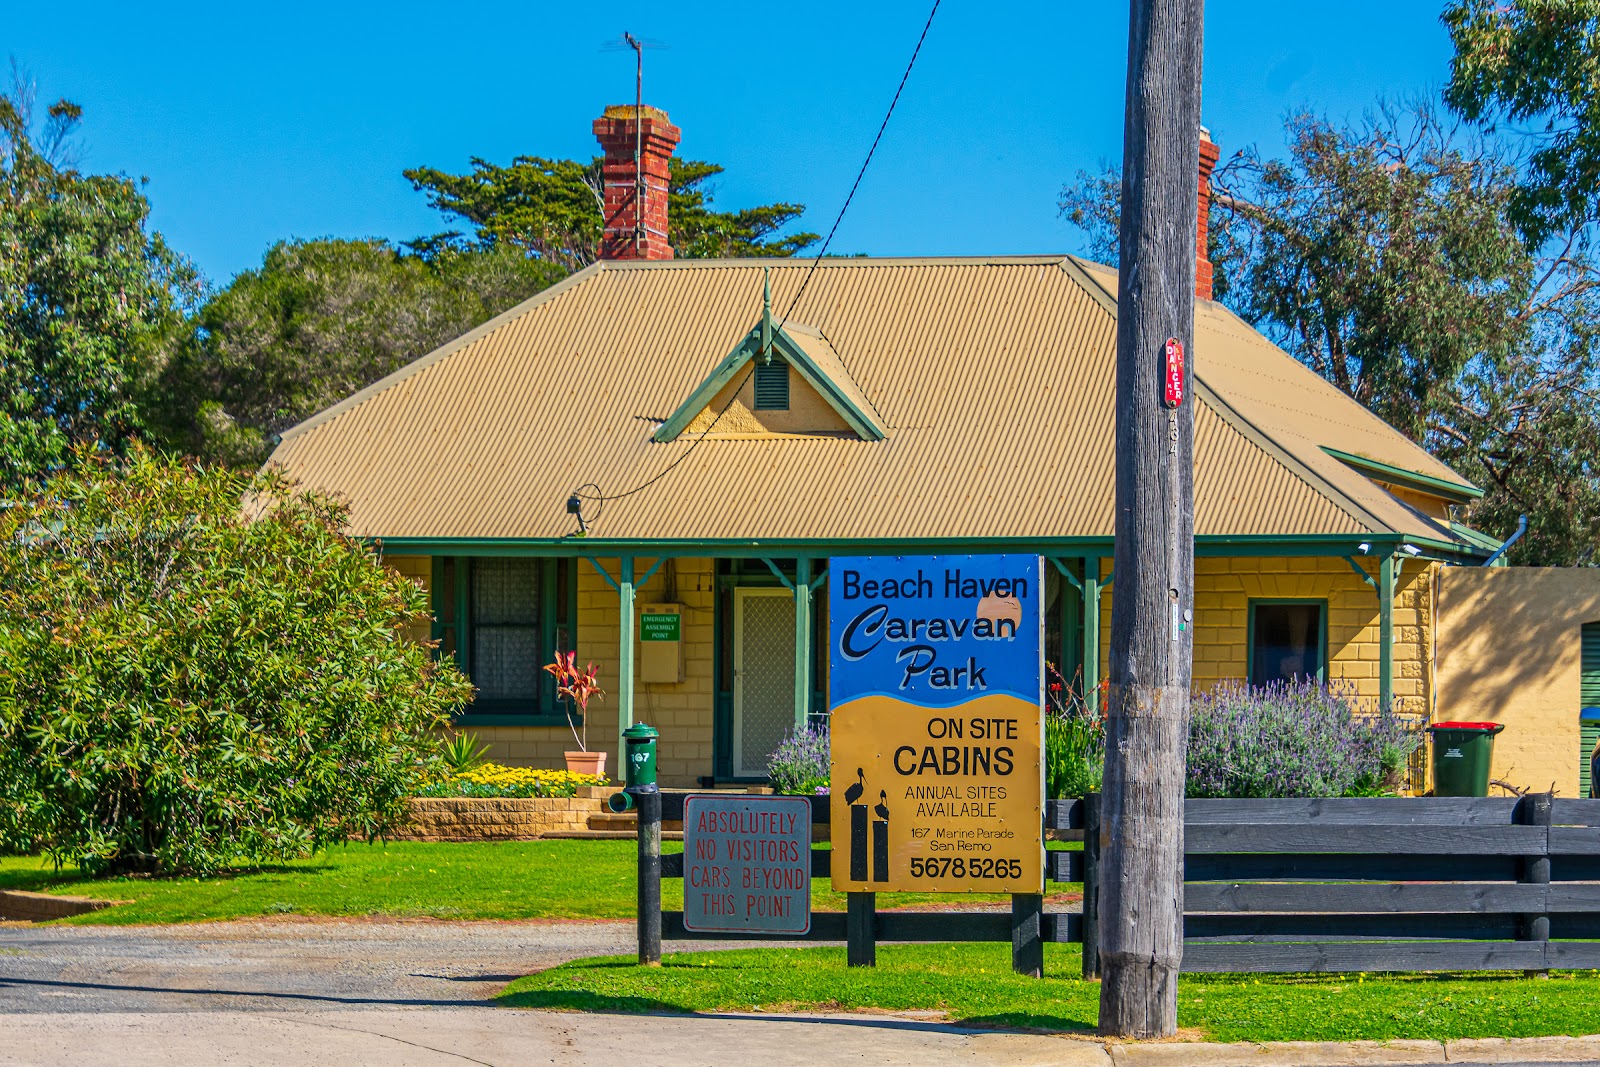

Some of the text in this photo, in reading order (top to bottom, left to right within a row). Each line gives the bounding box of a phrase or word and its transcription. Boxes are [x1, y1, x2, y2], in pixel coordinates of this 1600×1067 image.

[1166, 346, 1182, 400] DANGER
[843, 569, 1027, 599] Beach Haven
[839, 604, 1016, 661] Caravan
[896, 645, 987, 690] Park
[928, 718, 1018, 739] ON SITE
[631, 752, 650, 762] 167
[894, 746, 1014, 776] CABINS
[905, 786, 1007, 799] ANNUAL SITES
[916, 802, 996, 817] AVAILABLE
[698, 811, 796, 834] ABSOLUTELY
[911, 828, 1014, 838] 167 Marine Parade
[696, 839, 799, 862] NO VISITORS
[930, 840, 992, 851] San Remo
[691, 866, 804, 890] CARS BEYOND
[702, 894, 792, 917] THIS POINT
